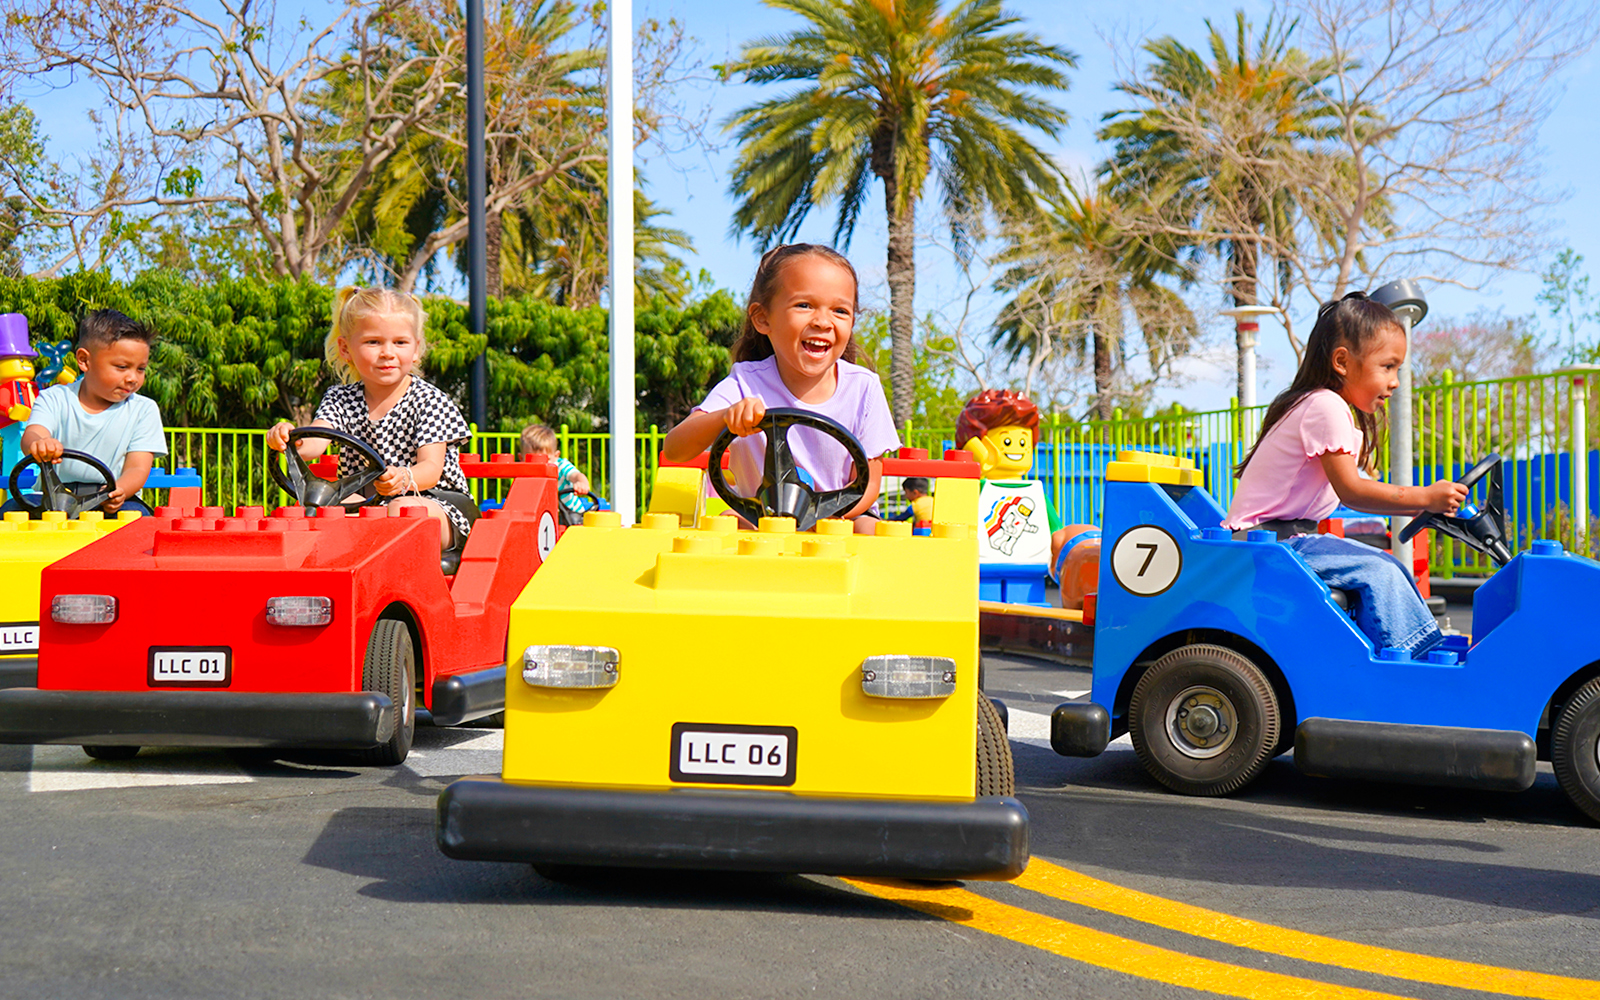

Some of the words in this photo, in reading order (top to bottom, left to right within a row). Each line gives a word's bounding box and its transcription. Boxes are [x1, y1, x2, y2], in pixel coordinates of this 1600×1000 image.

[543, 525, 550, 551] 1
[1136, 543, 1158, 577] 7
[3, 632, 33, 644] LLC
[159, 659, 191, 673] LLC
[199, 659, 219, 674] 01
[688, 742, 736, 764] LLC
[748, 744, 781, 765] 06
